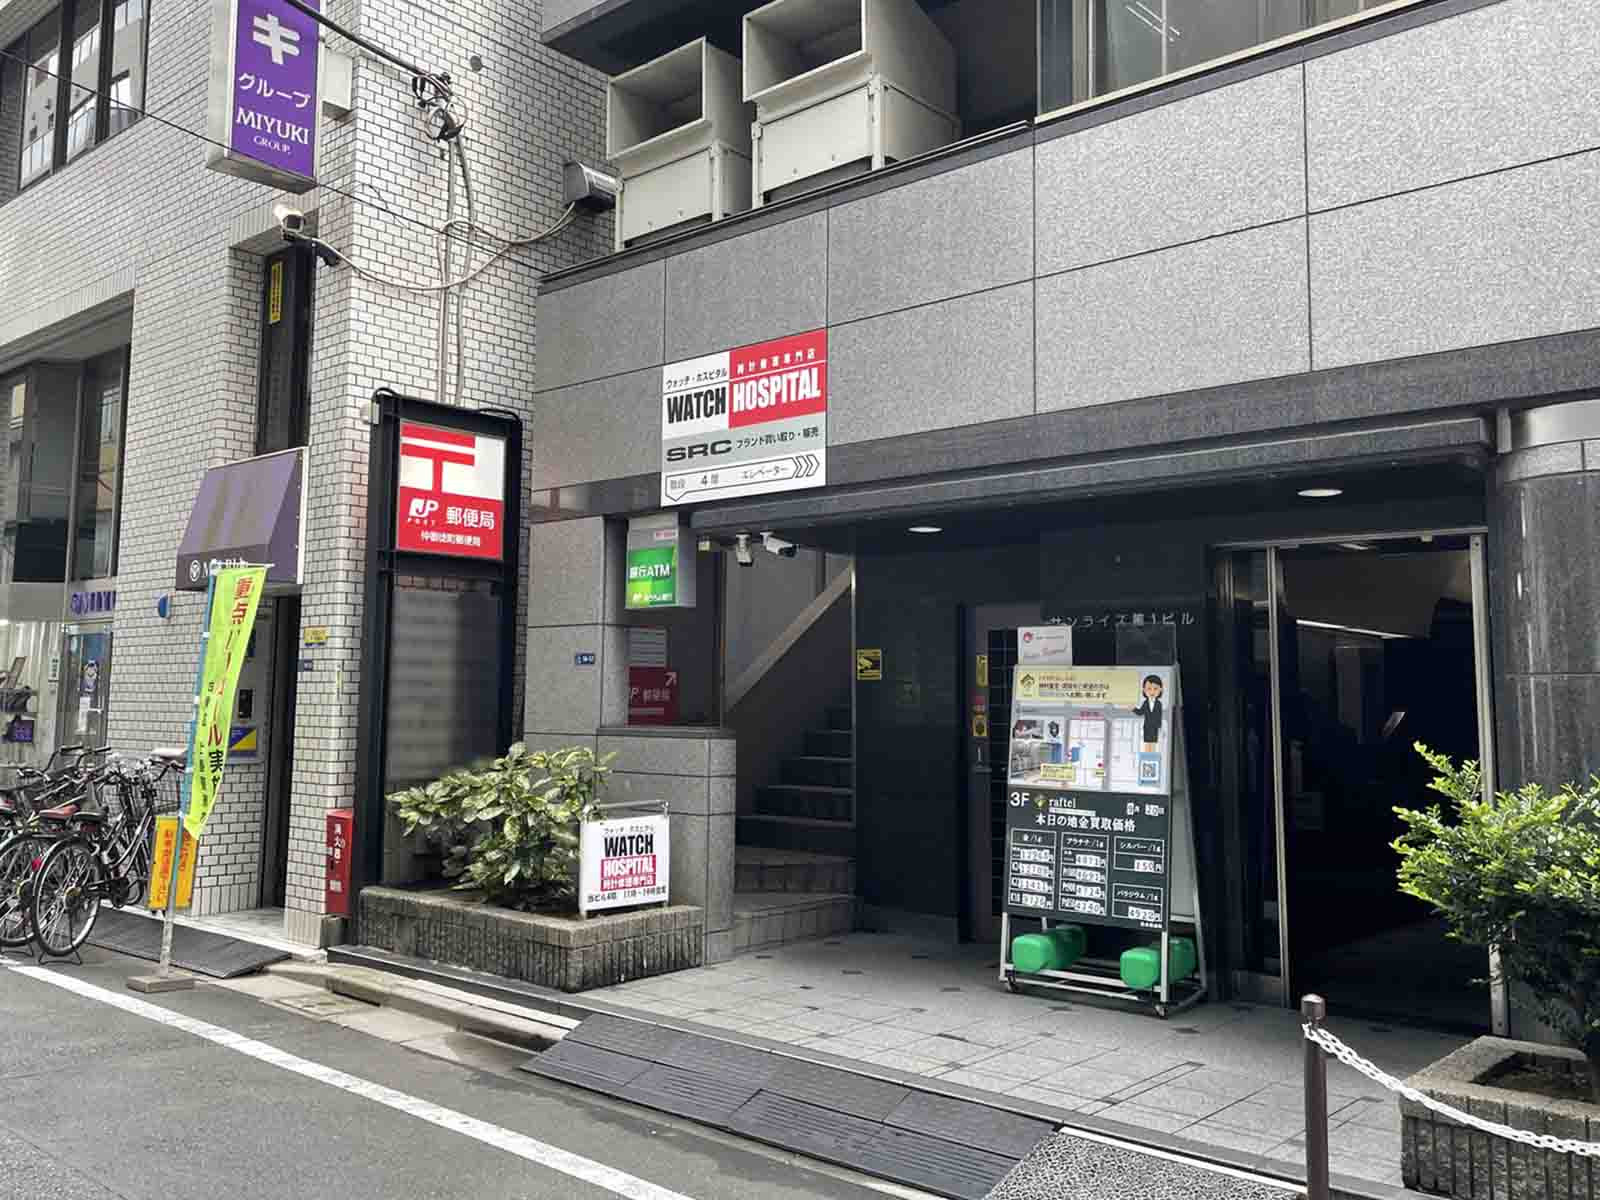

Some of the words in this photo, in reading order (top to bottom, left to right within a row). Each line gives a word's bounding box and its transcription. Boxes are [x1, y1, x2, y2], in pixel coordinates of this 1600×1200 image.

[238, 72, 311, 108] グループ
[236, 107, 309, 145] MIYUKI
[667, 387, 727, 425] WATCH
[732, 367, 821, 413] HOSPITAL
[666, 439, 732, 463] SRC
[408, 497, 439, 518] JP
[446, 505, 496, 531] 郵便局
[1010, 792, 1030, 807] 3F
[1035, 813, 1136, 833] 本日の地金買取価格
[604, 833, 654, 857] WATCH
[603, 856, 654, 878] HOSPITAL
